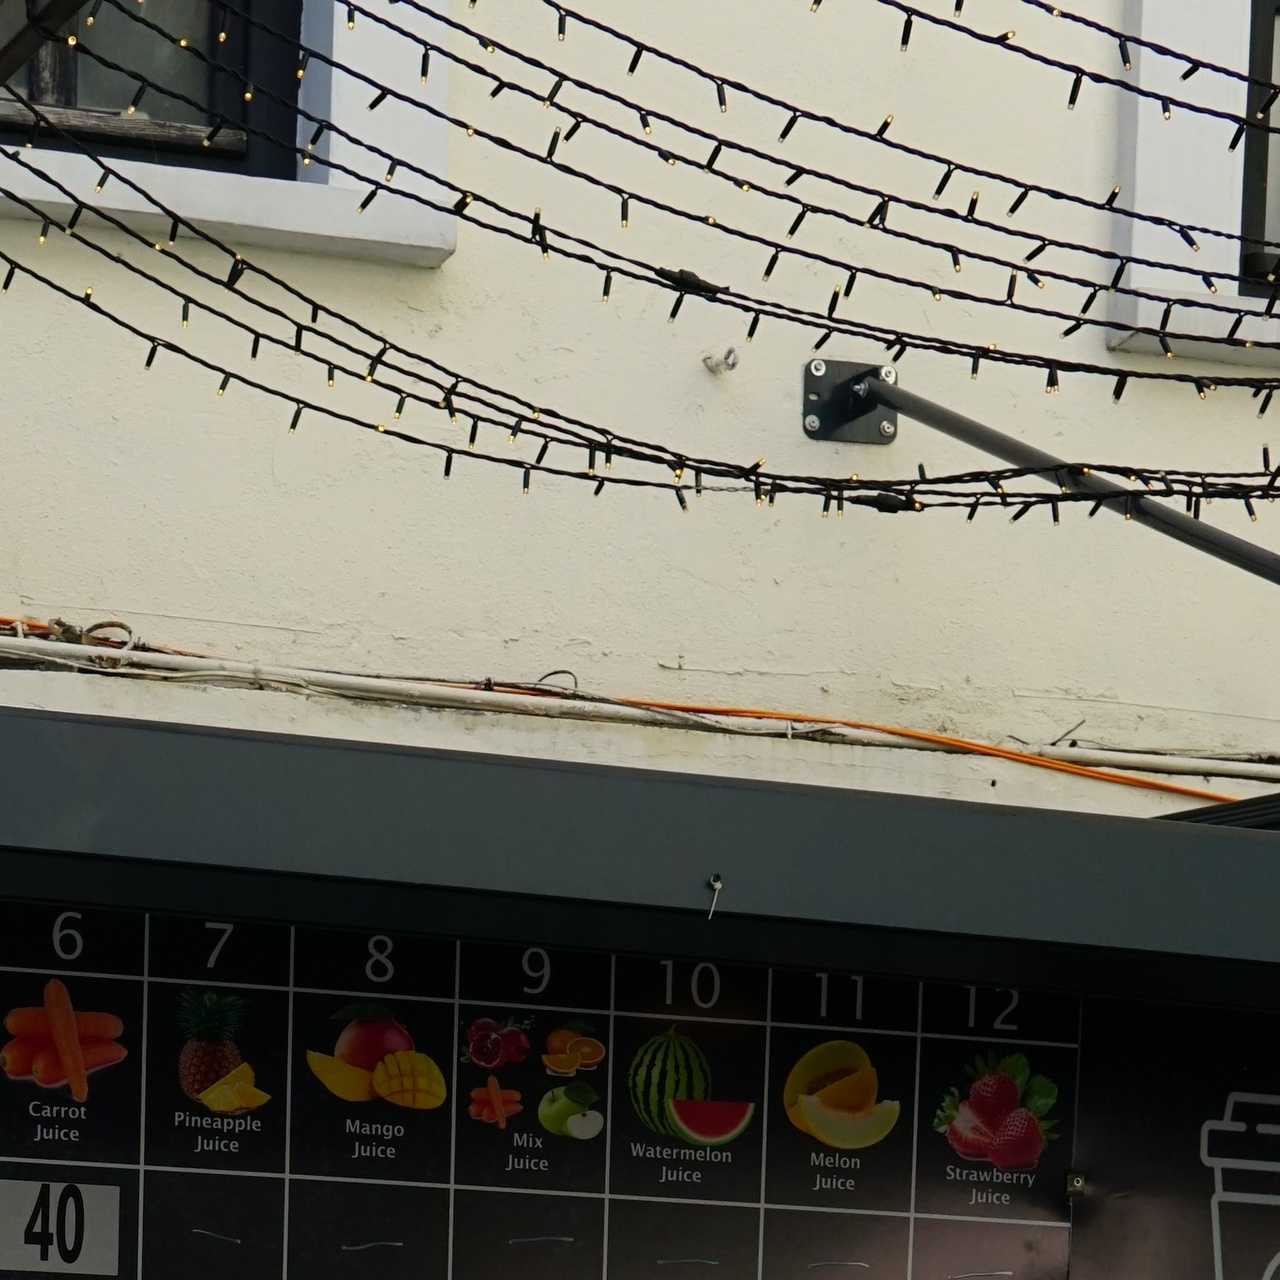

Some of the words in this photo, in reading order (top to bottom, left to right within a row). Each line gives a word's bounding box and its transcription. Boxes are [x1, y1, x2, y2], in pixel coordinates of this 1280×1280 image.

[53, 912, 83, 959] 6
[205, 922, 233, 968] 7
[365, 935, 394, 982] 8
[522, 948, 550, 993] 9
[661, 960, 720, 1008] 10
[816, 973, 863, 1019] 11
[964, 986, 1018, 1030] 12
[29, 1102, 86, 1119] Carrot
[175, 1112, 261, 1133] Pineapple
[346, 1119, 404, 1139] Mango
[34, 1125, 79, 1141] Juice
[514, 1133, 542, 1148] Mix
[194, 1136, 238, 1152] Juice
[352, 1142, 395, 1158] Juice
[631, 1143, 731, 1162] Watermelon
[505, 1155, 548, 1170] Juice
[811, 1153, 860, 1168] Melon
[659, 1166, 701, 1182] Juice
[813, 1174, 854, 1190] Juice
[946, 1166, 1035, 1187] Strawberry
[969, 1189, 1009, 1204] Juice
[25, 1184, 84, 1264] 40
